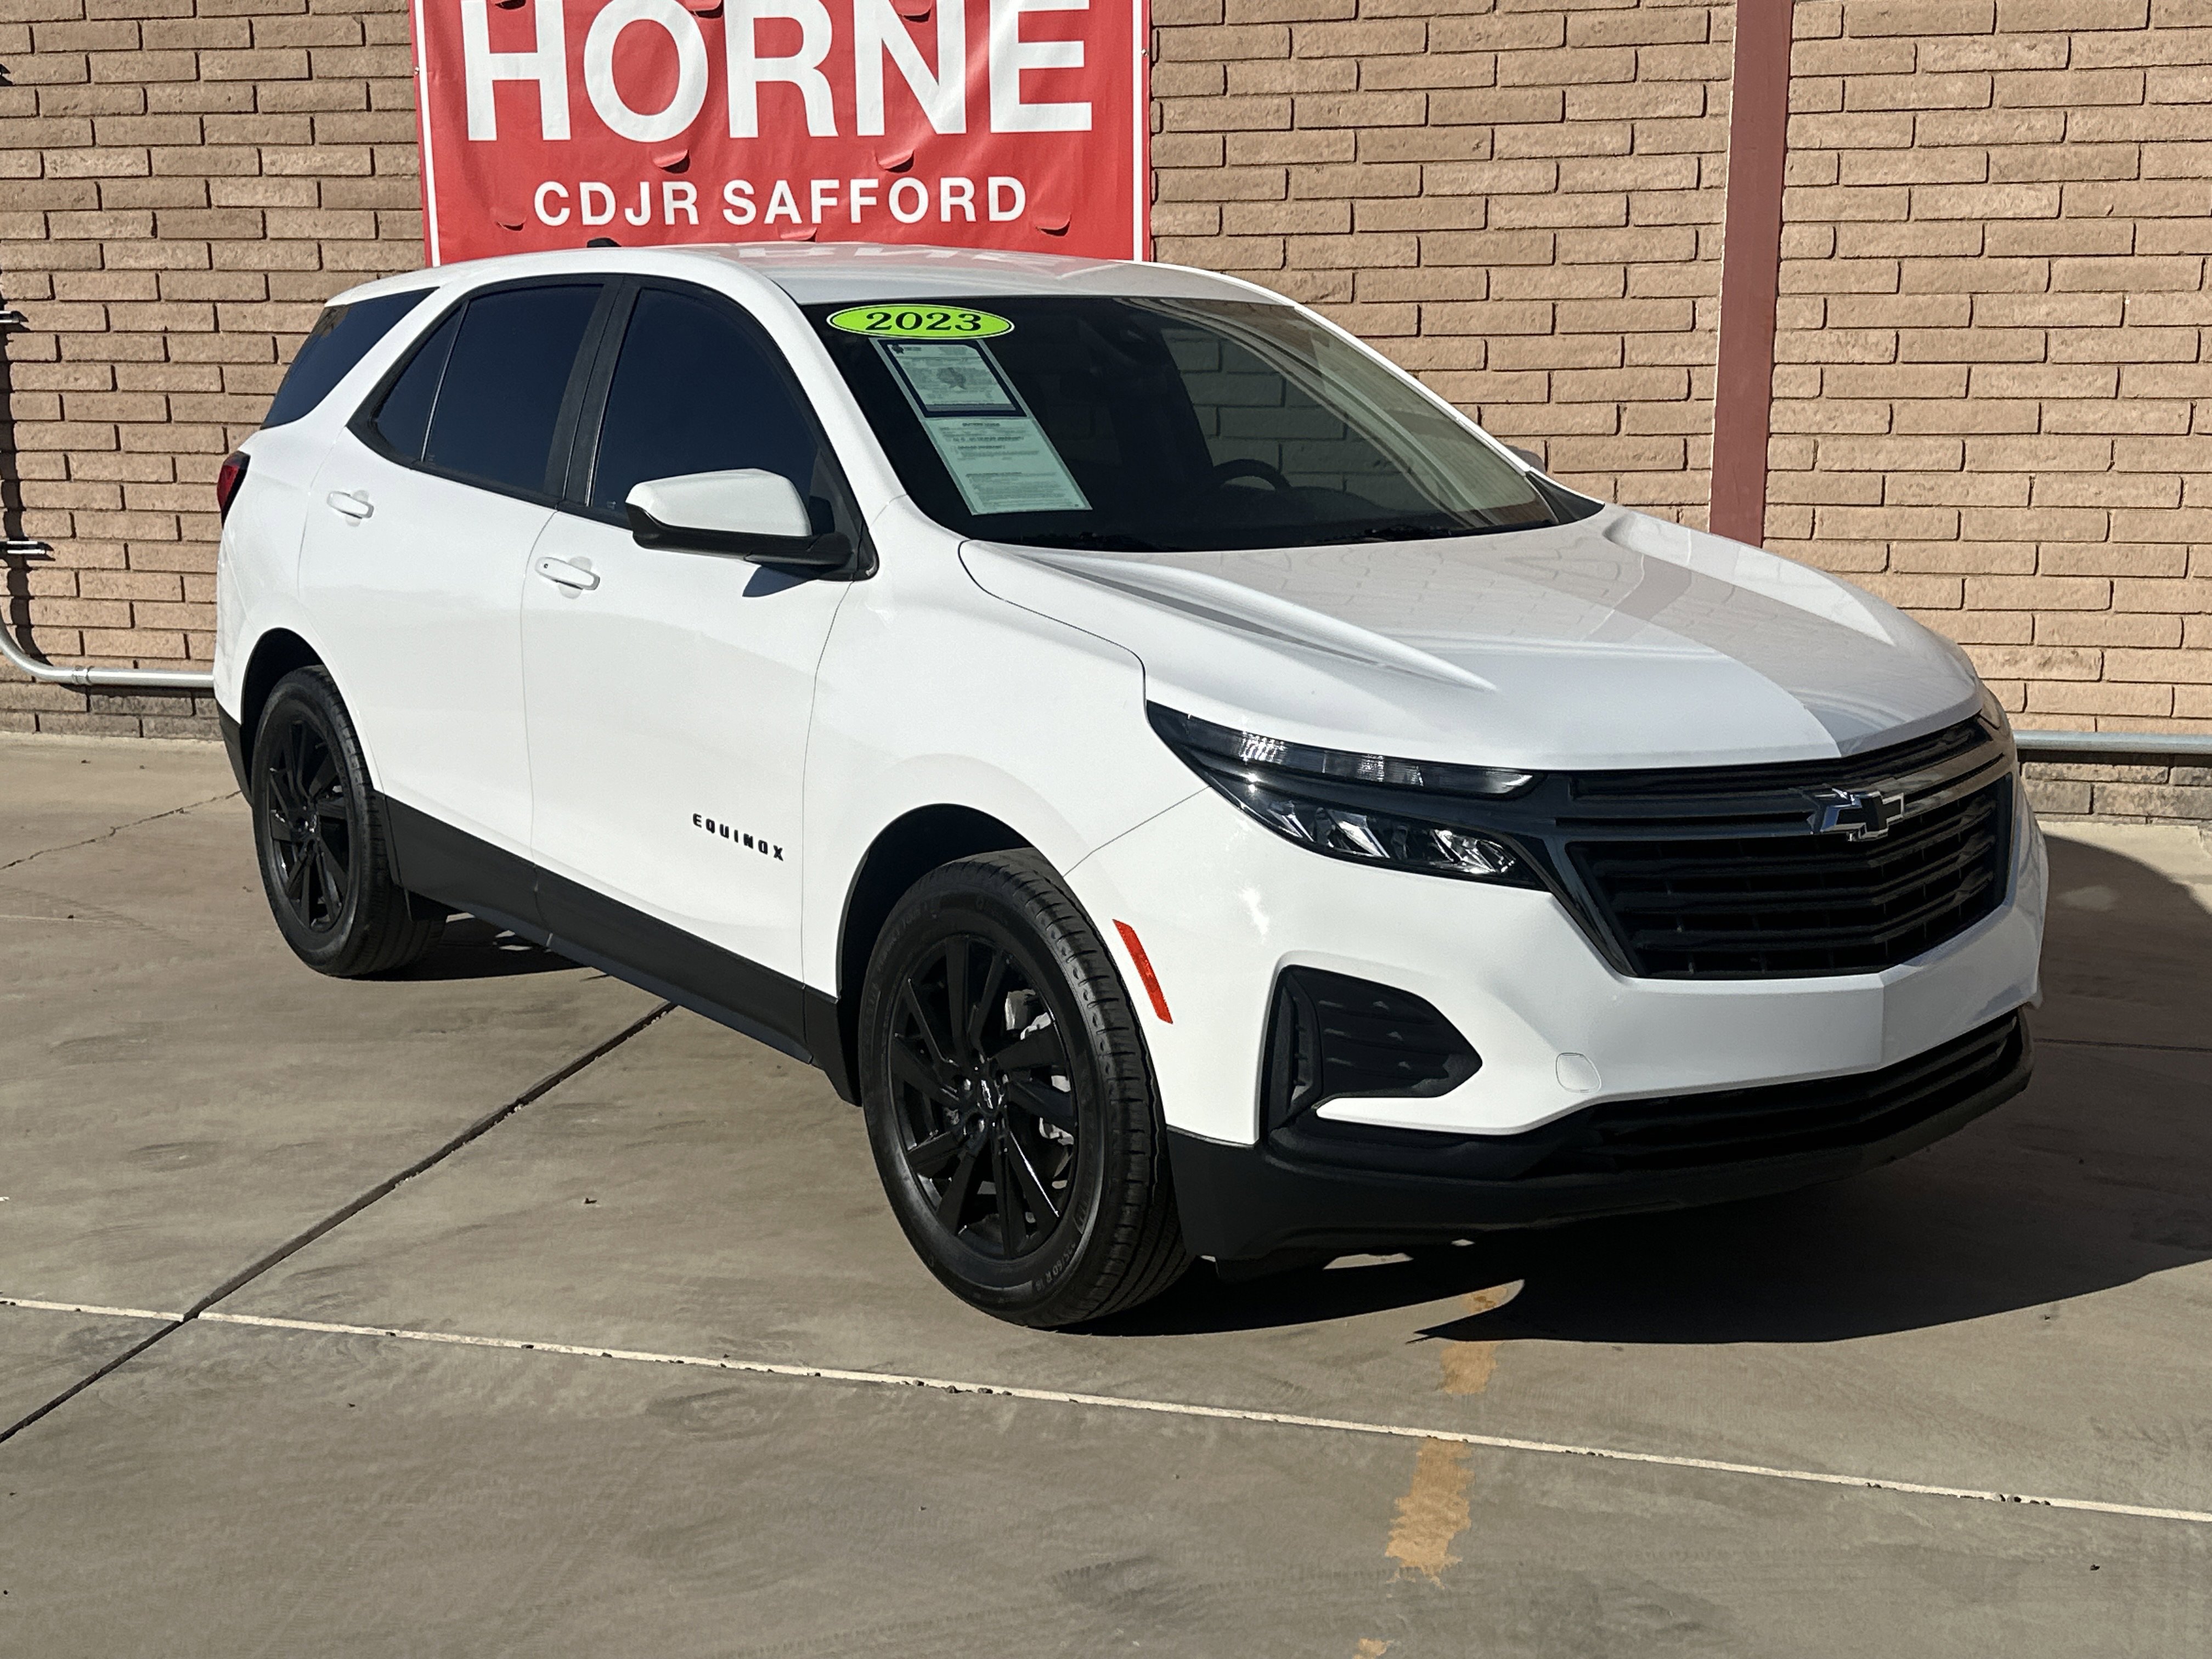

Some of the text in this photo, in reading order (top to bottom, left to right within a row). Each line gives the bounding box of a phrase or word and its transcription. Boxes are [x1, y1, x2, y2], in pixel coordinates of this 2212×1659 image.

[460, 0, 1093, 143] HORNE
[534, 176, 1026, 226] CDJR SAFFORD
[865, 311, 981, 332] 2023
[692, 812, 784, 861] EQUINOX
